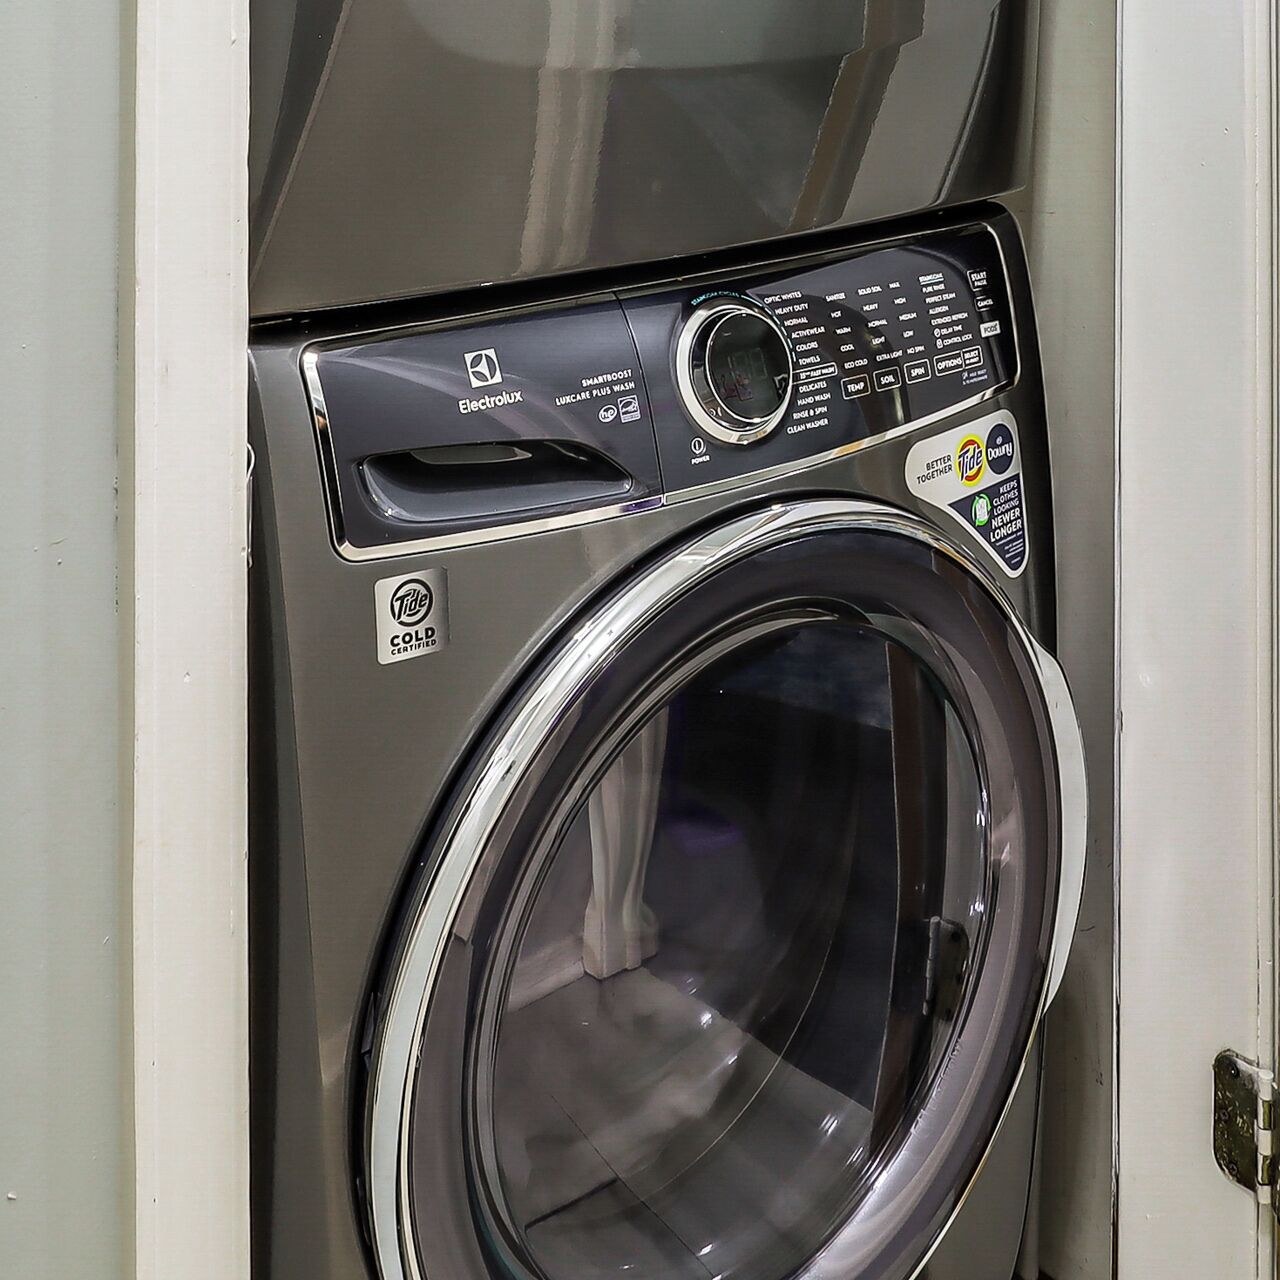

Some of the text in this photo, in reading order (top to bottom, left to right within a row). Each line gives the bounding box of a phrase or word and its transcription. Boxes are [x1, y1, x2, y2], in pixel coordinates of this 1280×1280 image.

[970, 271, 987, 282] START
[763, 290, 803, 305] OPTIC WHITES
[774, 302, 809, 316] HEAVY DUTY
[783, 316, 809, 327] NORMAL
[791, 326, 826, 339] ACTIVEWEAR
[943, 333, 974, 346] CONTROL LOCK
[795, 340, 819, 352] COLORS
[840, 343, 856, 353] COOL
[798, 354, 821, 366] TOWELS
[876, 349, 904, 362] EXTRA LIGHT
[963, 349, 980, 360] SELECT
[844, 358, 869, 370] ECO COLD
[937, 356, 963, 370] OPTIONS
[581, 368, 633, 388] SMARTBOOST
[910, 366, 926, 377] SPIN
[798, 380, 827, 394] DELICATES
[846, 381, 866, 393] TEMP
[880, 374, 896, 385] SOIL
[554, 380, 636, 407] LUXCARE PLUS WASH
[796, 392, 832, 407] HAND WASH
[457, 389, 524, 415] Electrolux
[792, 409, 809, 420] RINSE
[814, 405, 828, 416] SPIN
[786, 418, 830, 435] CLEAN WASHER
[987, 441, 1013, 461] Downy
[925, 454, 952, 472] BETTER
[958, 443, 983, 482] Tide
[916, 464, 953, 485] TOGETHER
[999, 480, 1018, 495] KEEPS
[992, 488, 1019, 507] CLOTHES
[993, 497, 1020, 516] LOOKING
[991, 507, 1021, 530] NEWER
[990, 519, 1023, 543] LONGER
[394, 587, 429, 622] Tide
[389, 626, 436, 648] COLD
[390, 638, 437, 656] CERTIFIED
